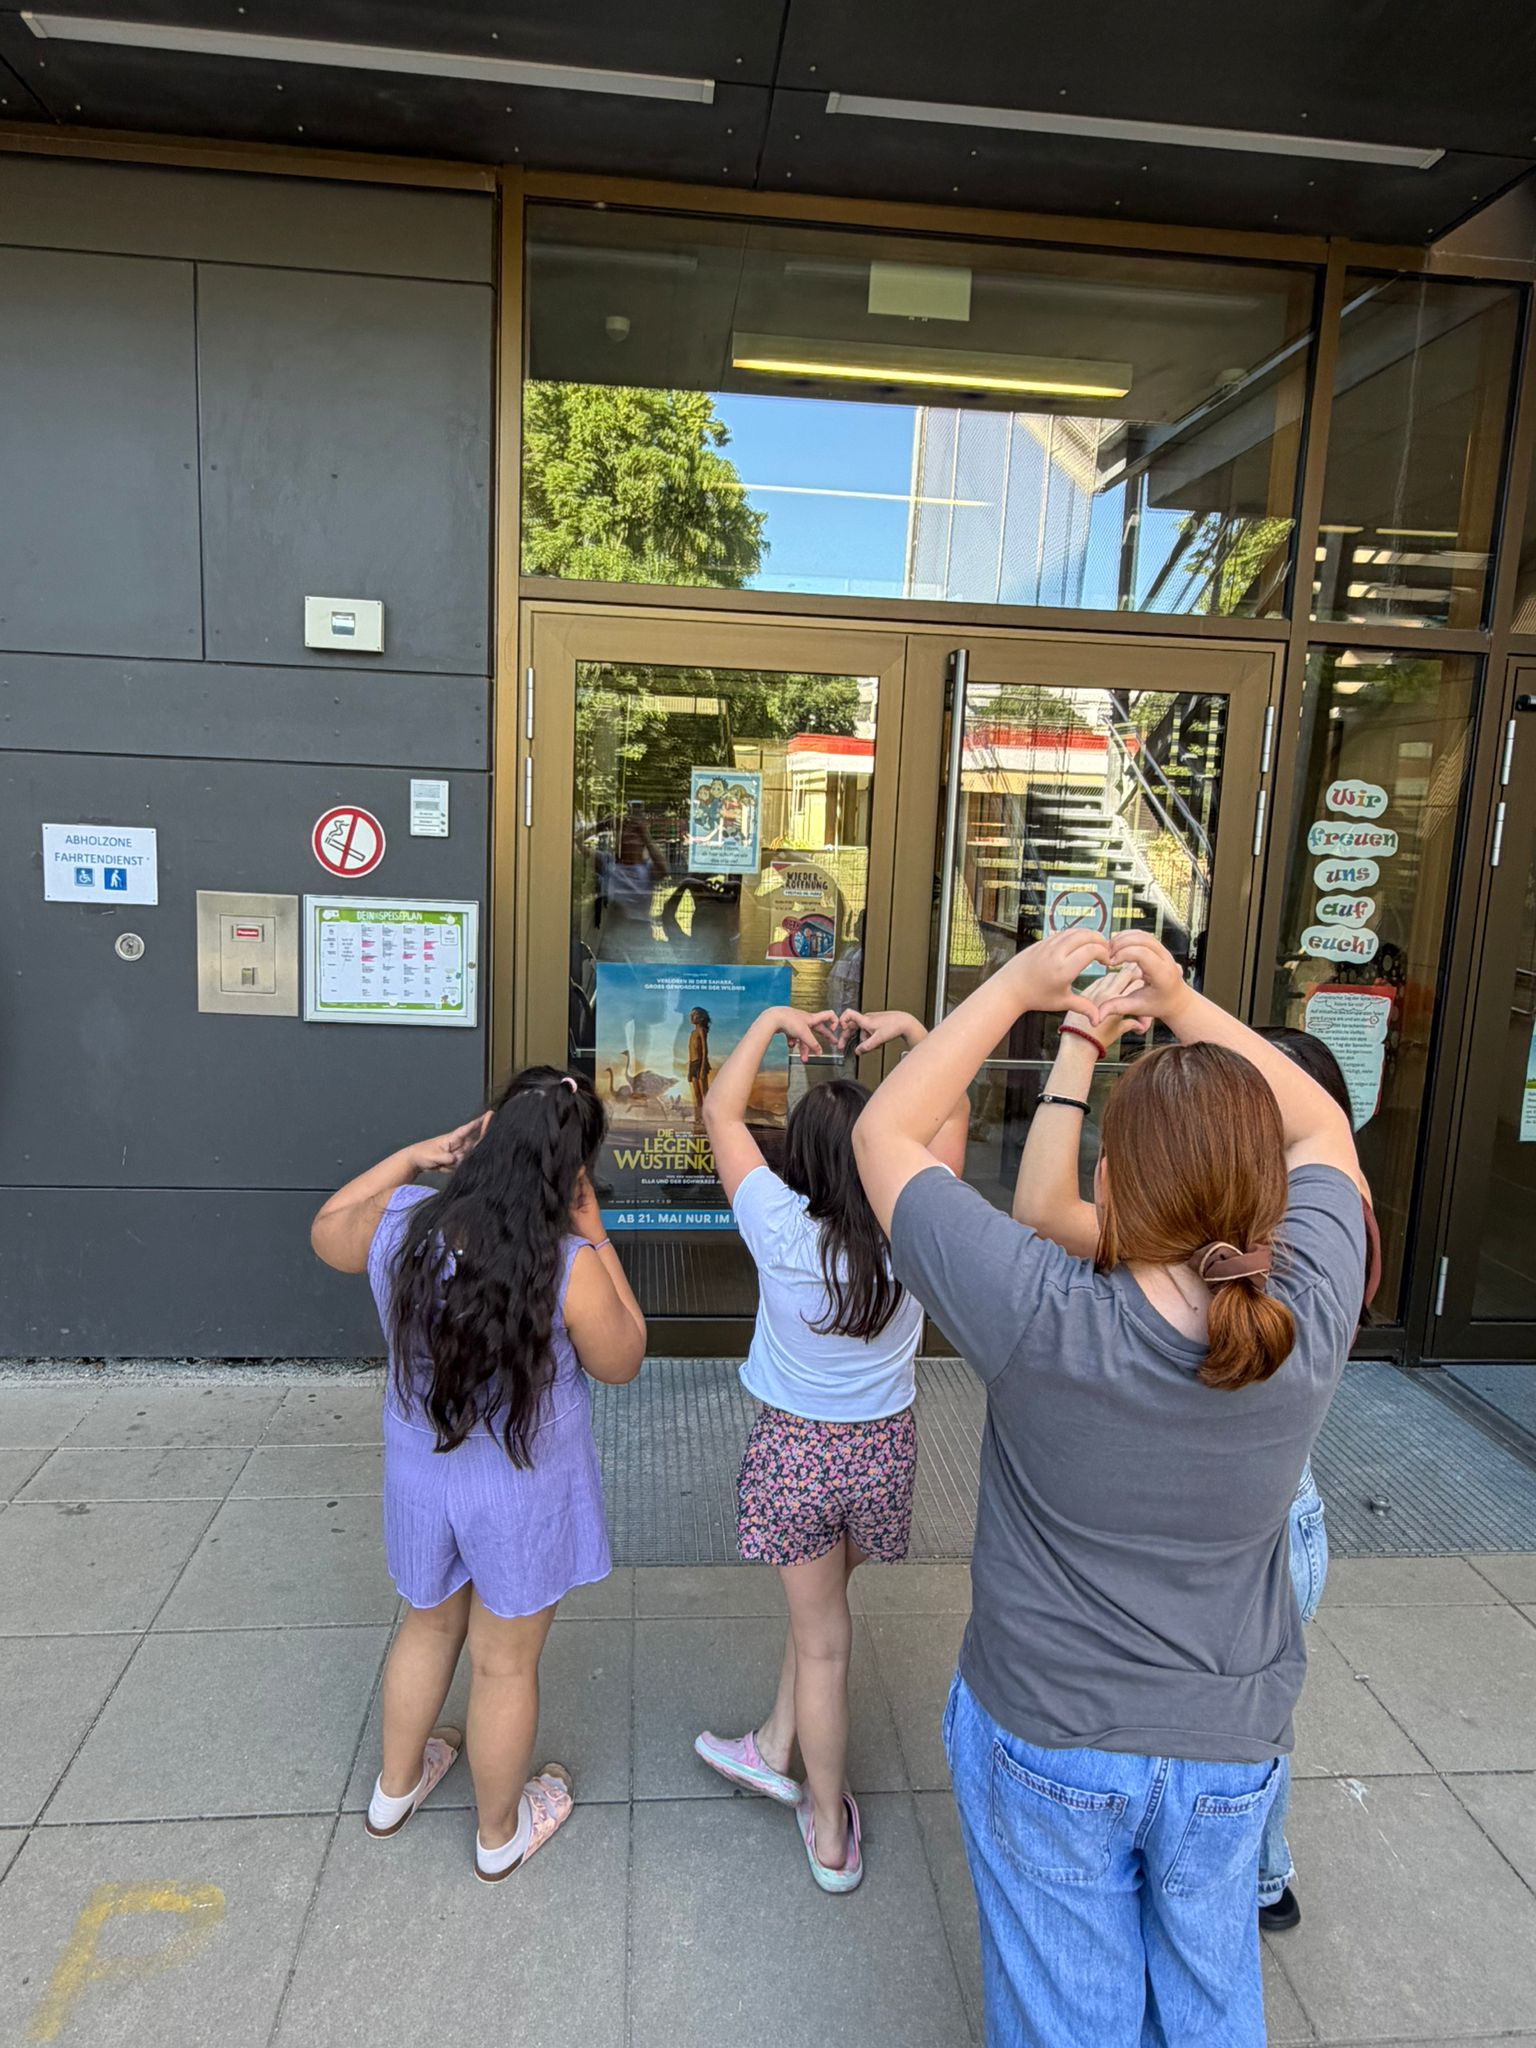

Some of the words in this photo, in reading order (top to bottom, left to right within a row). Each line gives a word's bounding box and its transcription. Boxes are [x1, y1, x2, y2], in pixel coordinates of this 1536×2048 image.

[1332, 787, 1381, 808] Wir
[65, 835, 132, 848] ABHOLZONE
[1310, 827, 1396, 848] freuen
[55, 852, 144, 866] FAHRTENDIENST
[787, 872, 822, 880] WIEDER-
[1326, 867, 1370, 884] uns
[356, 911, 374, 920] DEIN
[1322, 901, 1368, 919] auf
[1308, 935, 1375, 955] euch!
[657, 1128, 674, 1138] DIE
[644, 1138, 712, 1153] LEGEND
[613, 1150, 715, 1173] WÜSTENKI
[617, 1214, 635, 1223] AB
[638, 1214, 654, 1223] 21.
[658, 1214, 682, 1223] MAI
[685, 1214, 711, 1224] NUR
[715, 1215, 730, 1223] IM
